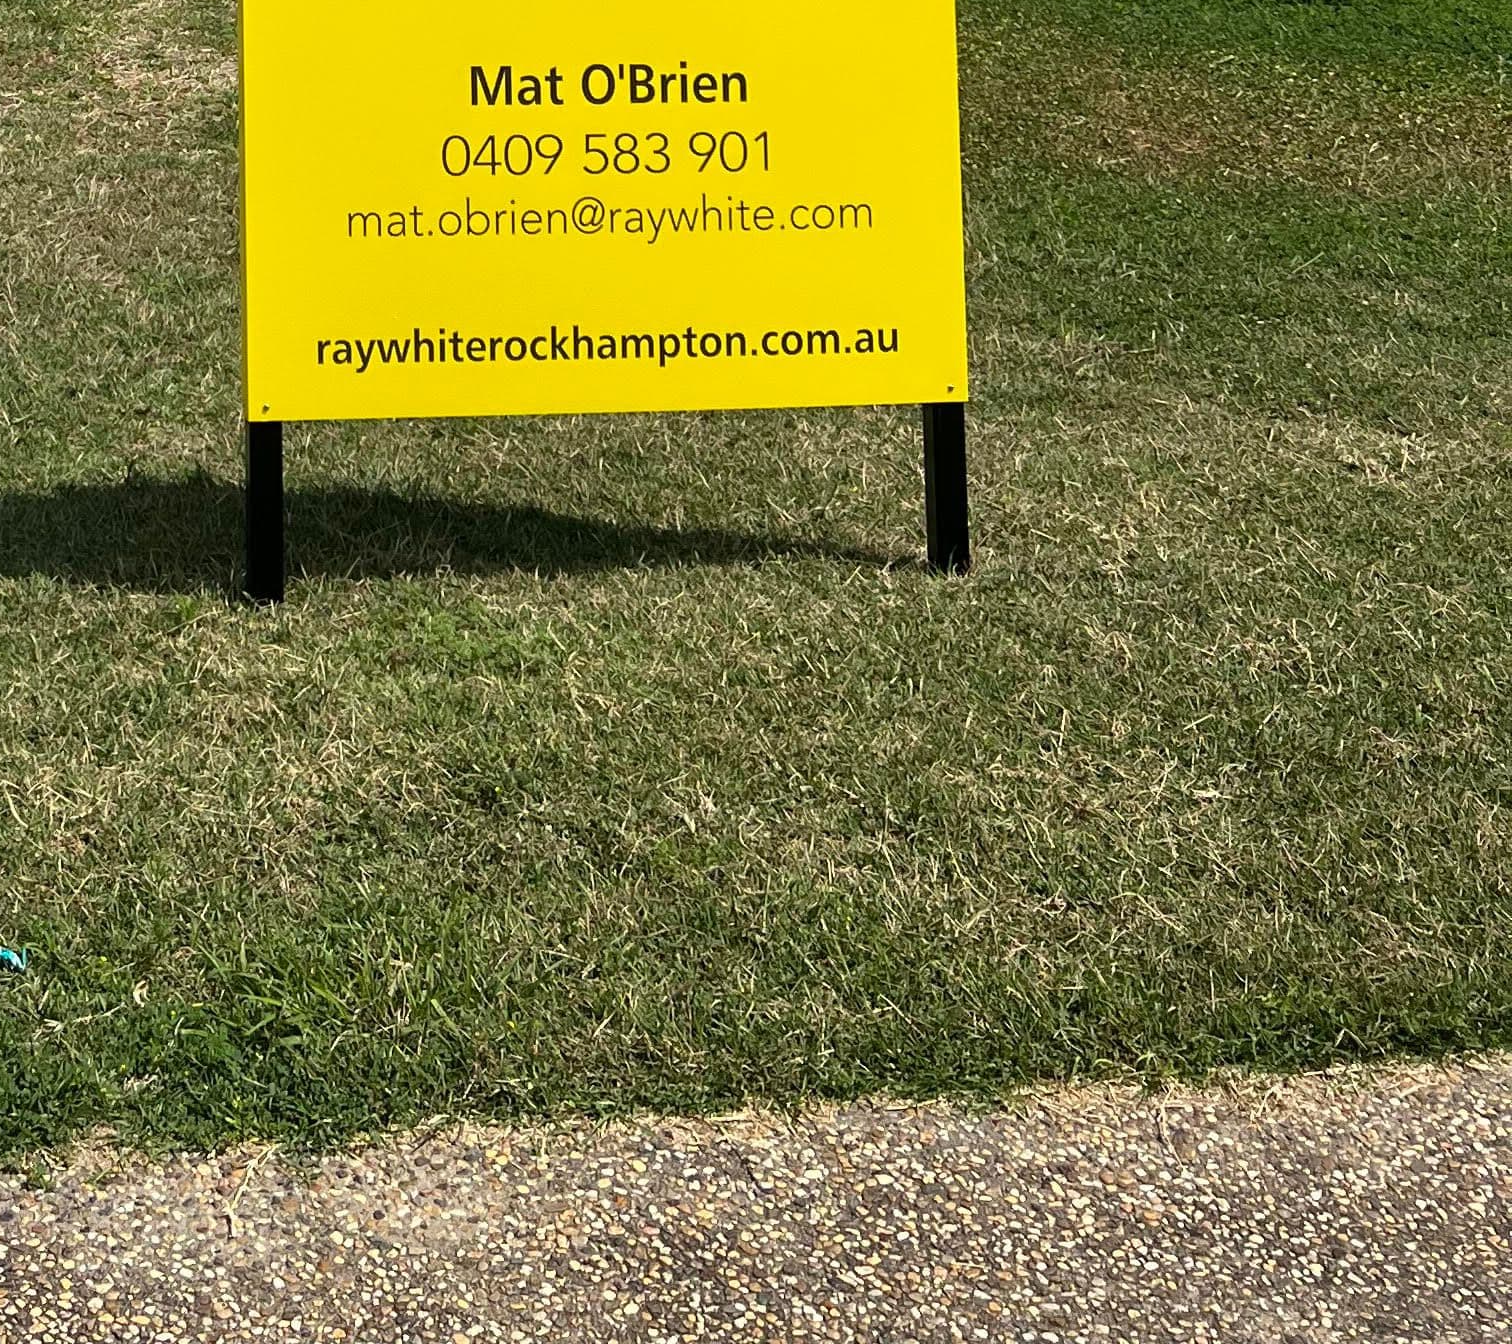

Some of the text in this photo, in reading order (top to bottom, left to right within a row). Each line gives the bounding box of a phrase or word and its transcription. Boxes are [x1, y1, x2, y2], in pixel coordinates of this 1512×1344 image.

[471, 61, 748, 107] Mat O'Brien
[441, 130, 770, 177] 0409 583 901
[347, 192, 874, 245] mat.obrien@raywhite.com
[317, 325, 899, 374] raywhiterockhampton.com.au
